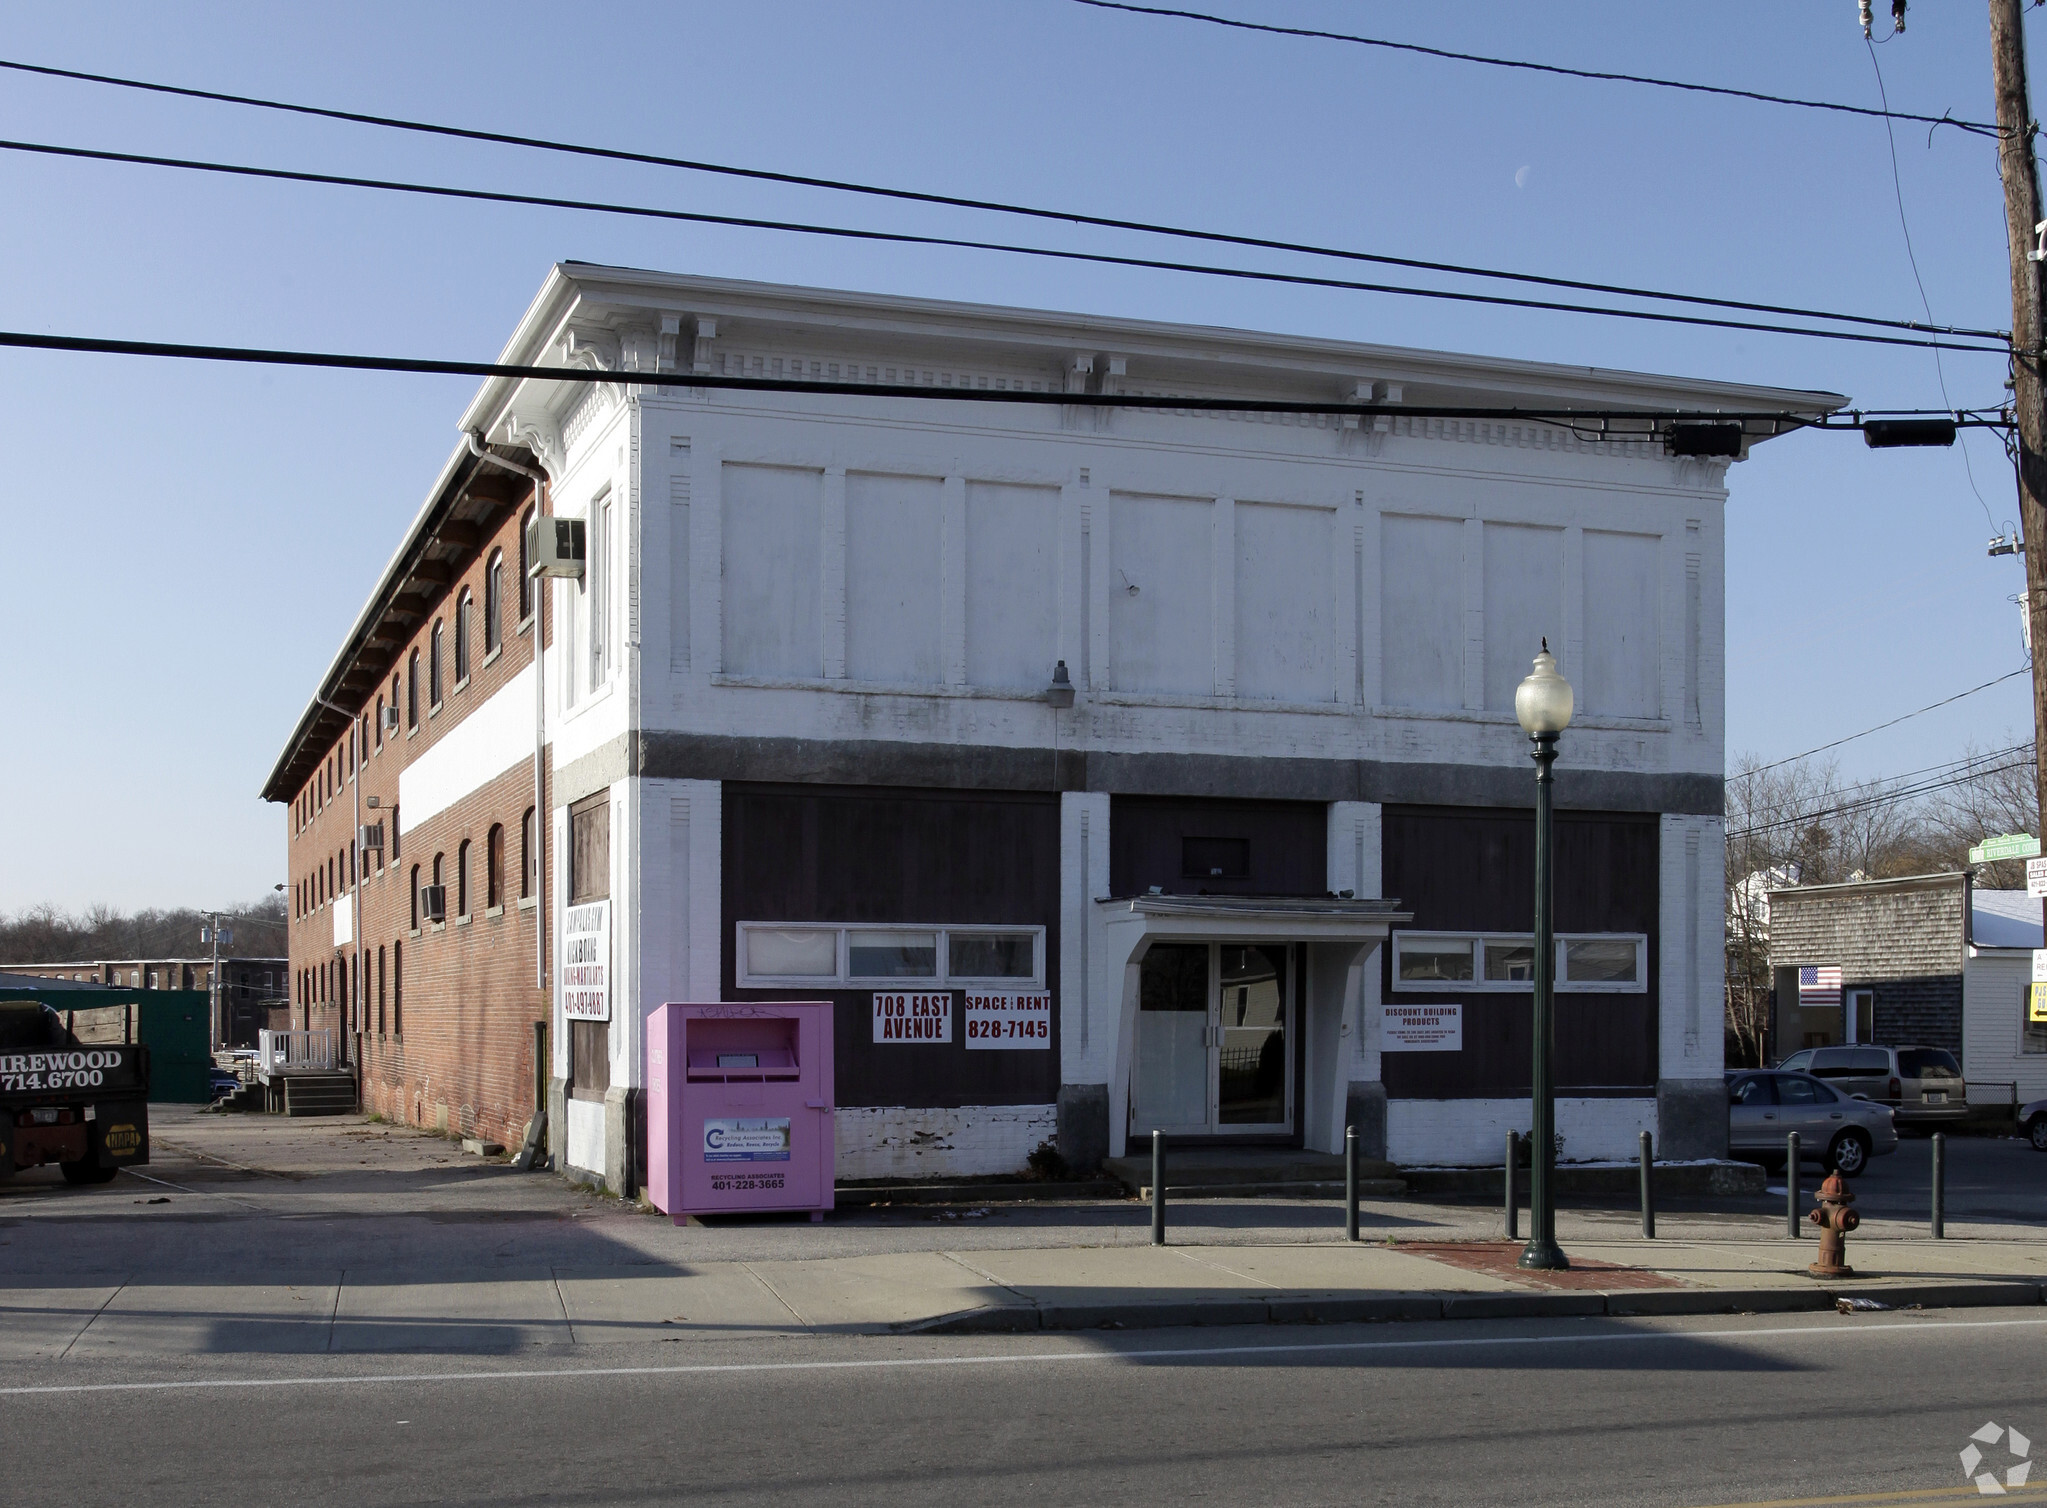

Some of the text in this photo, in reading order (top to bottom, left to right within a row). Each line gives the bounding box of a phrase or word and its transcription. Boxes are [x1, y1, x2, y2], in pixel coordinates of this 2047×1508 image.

[1986, 844, 2020, 858] RIVERDALE
[2022, 842, 2039, 853] COUR
[876, 995, 950, 1017] 708 EAST
[966, 996, 1007, 1010] SPACE
[1017, 996, 1050, 1010] RENT
[1385, 1008, 1457, 1017] DISCOUNT BUILDING
[883, 1018, 942, 1039] AVENUE
[968, 1020, 1048, 1038] 828-7145
[1402, 1017, 1440, 1026] PRODUCTS
[0, 1050, 123, 1073] IREWOOD
[1, 1069, 104, 1091] 714.6700
[109, 1131, 137, 1148] NAPA
[712, 1179, 785, 1190] 401-228-3665
